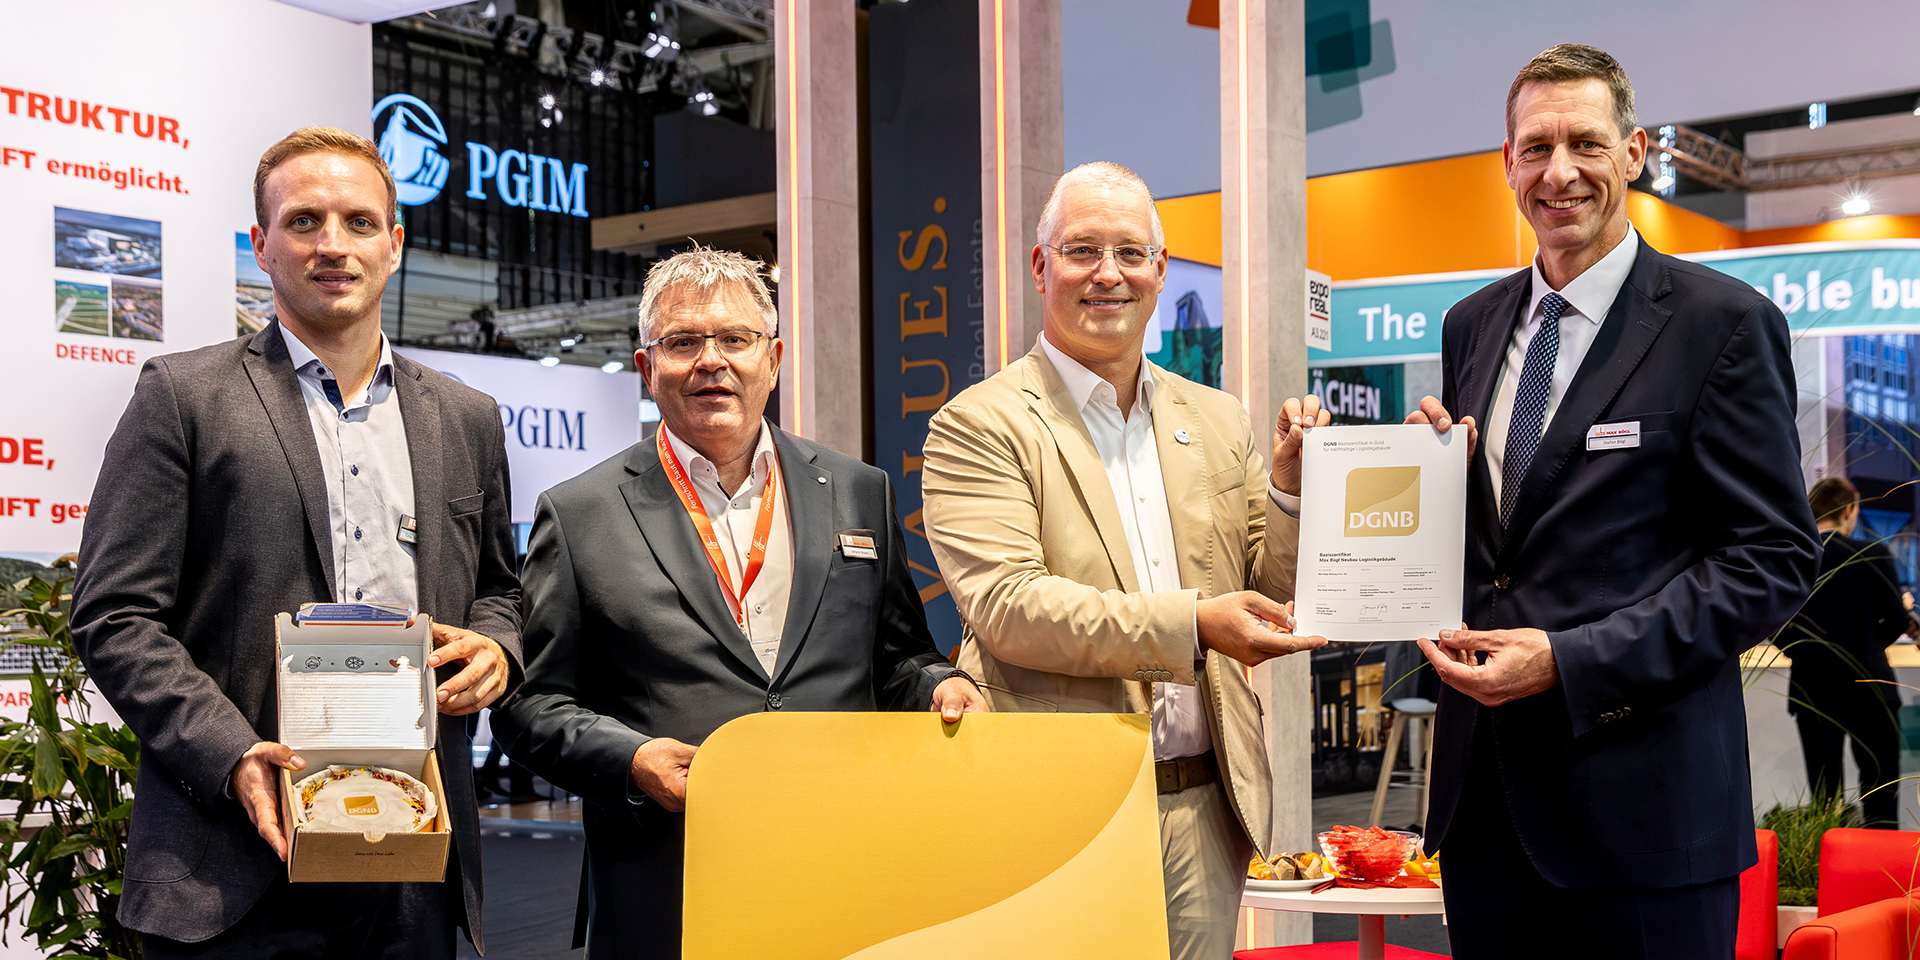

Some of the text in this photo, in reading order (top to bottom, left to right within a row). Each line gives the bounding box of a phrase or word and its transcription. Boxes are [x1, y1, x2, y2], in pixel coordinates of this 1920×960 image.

[0, 86, 190, 149] TRUKTUR,
[0, 147, 190, 195] FT ermöglicht.
[465, 141, 589, 218] PGIM
[1871, 267, 1920, 310] bu
[1357, 303, 1427, 342] The
[56, 343, 137, 365] DEFENCE
[0, 437, 55, 471] DE,
[1349, 511, 1415, 529] DGNB
